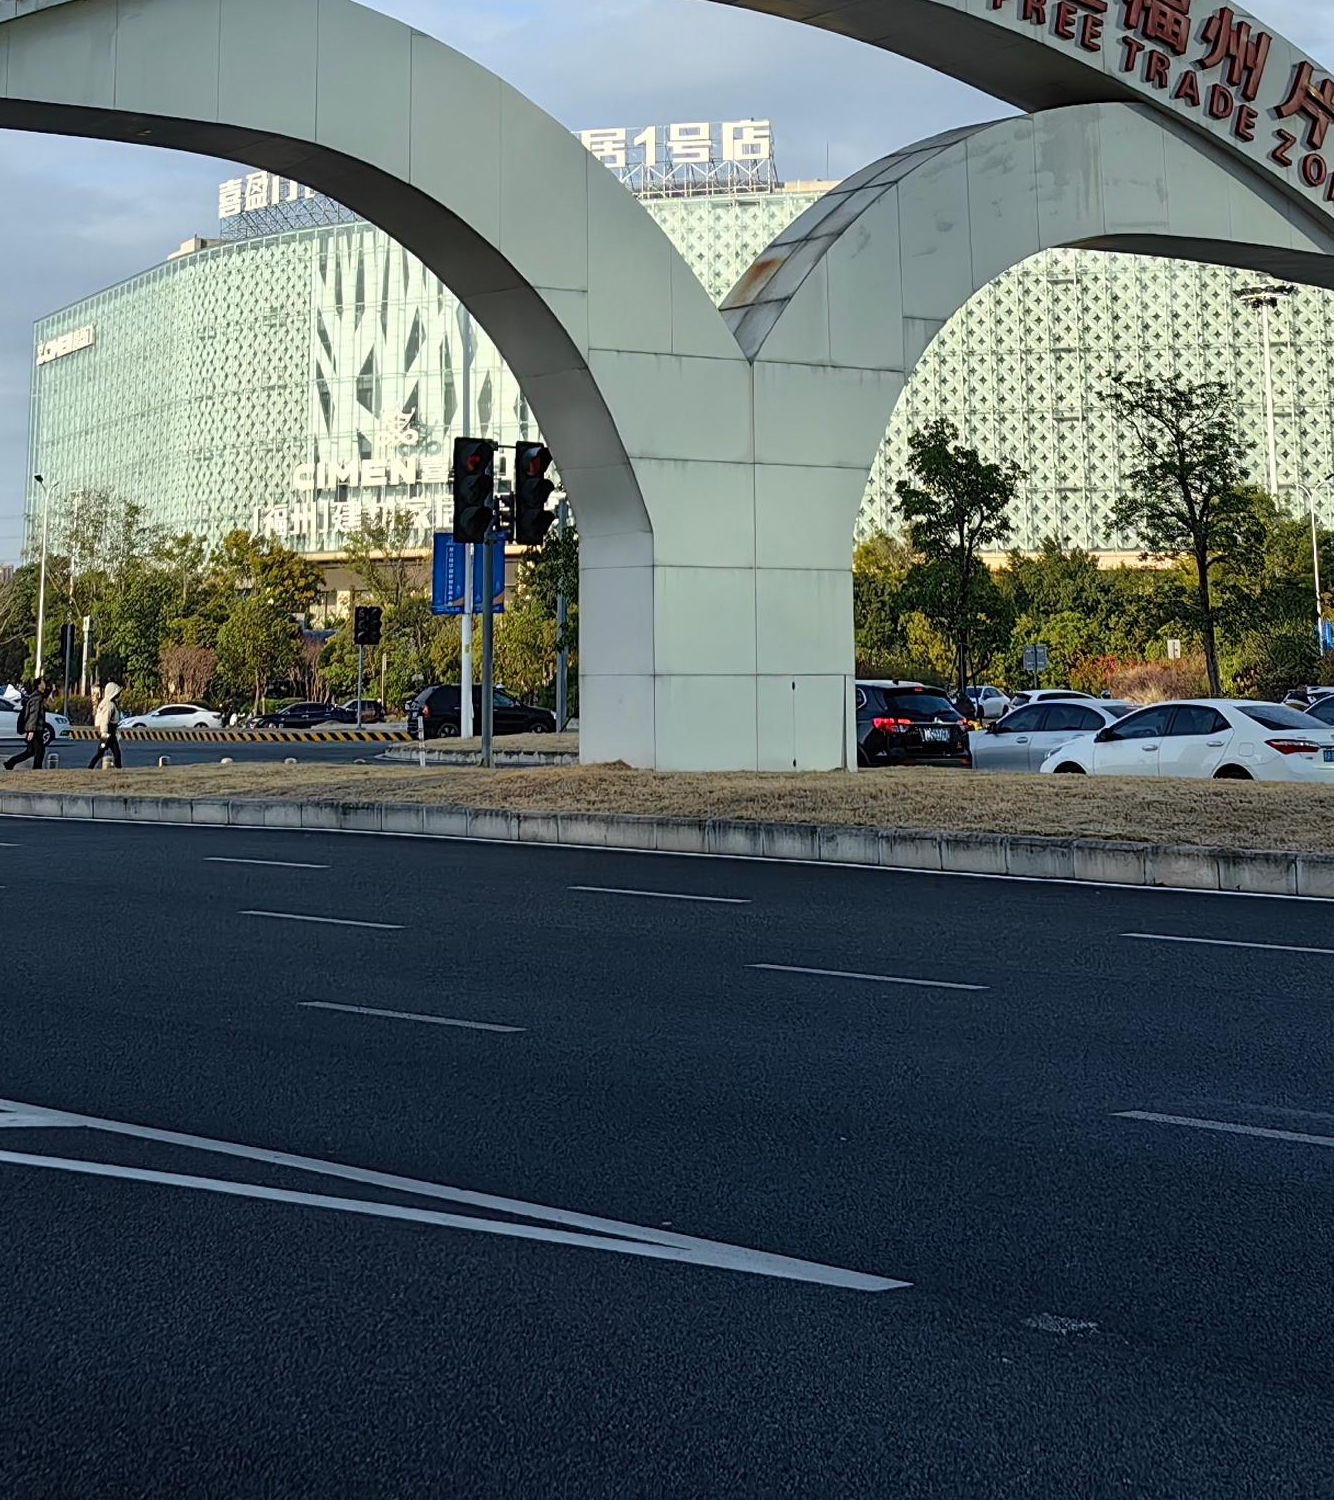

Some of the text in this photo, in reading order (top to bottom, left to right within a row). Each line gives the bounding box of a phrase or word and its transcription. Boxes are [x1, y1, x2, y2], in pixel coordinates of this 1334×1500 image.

[1122, 35, 1259, 143] TRADE
[219, 171, 320, 218] 喜盈门
